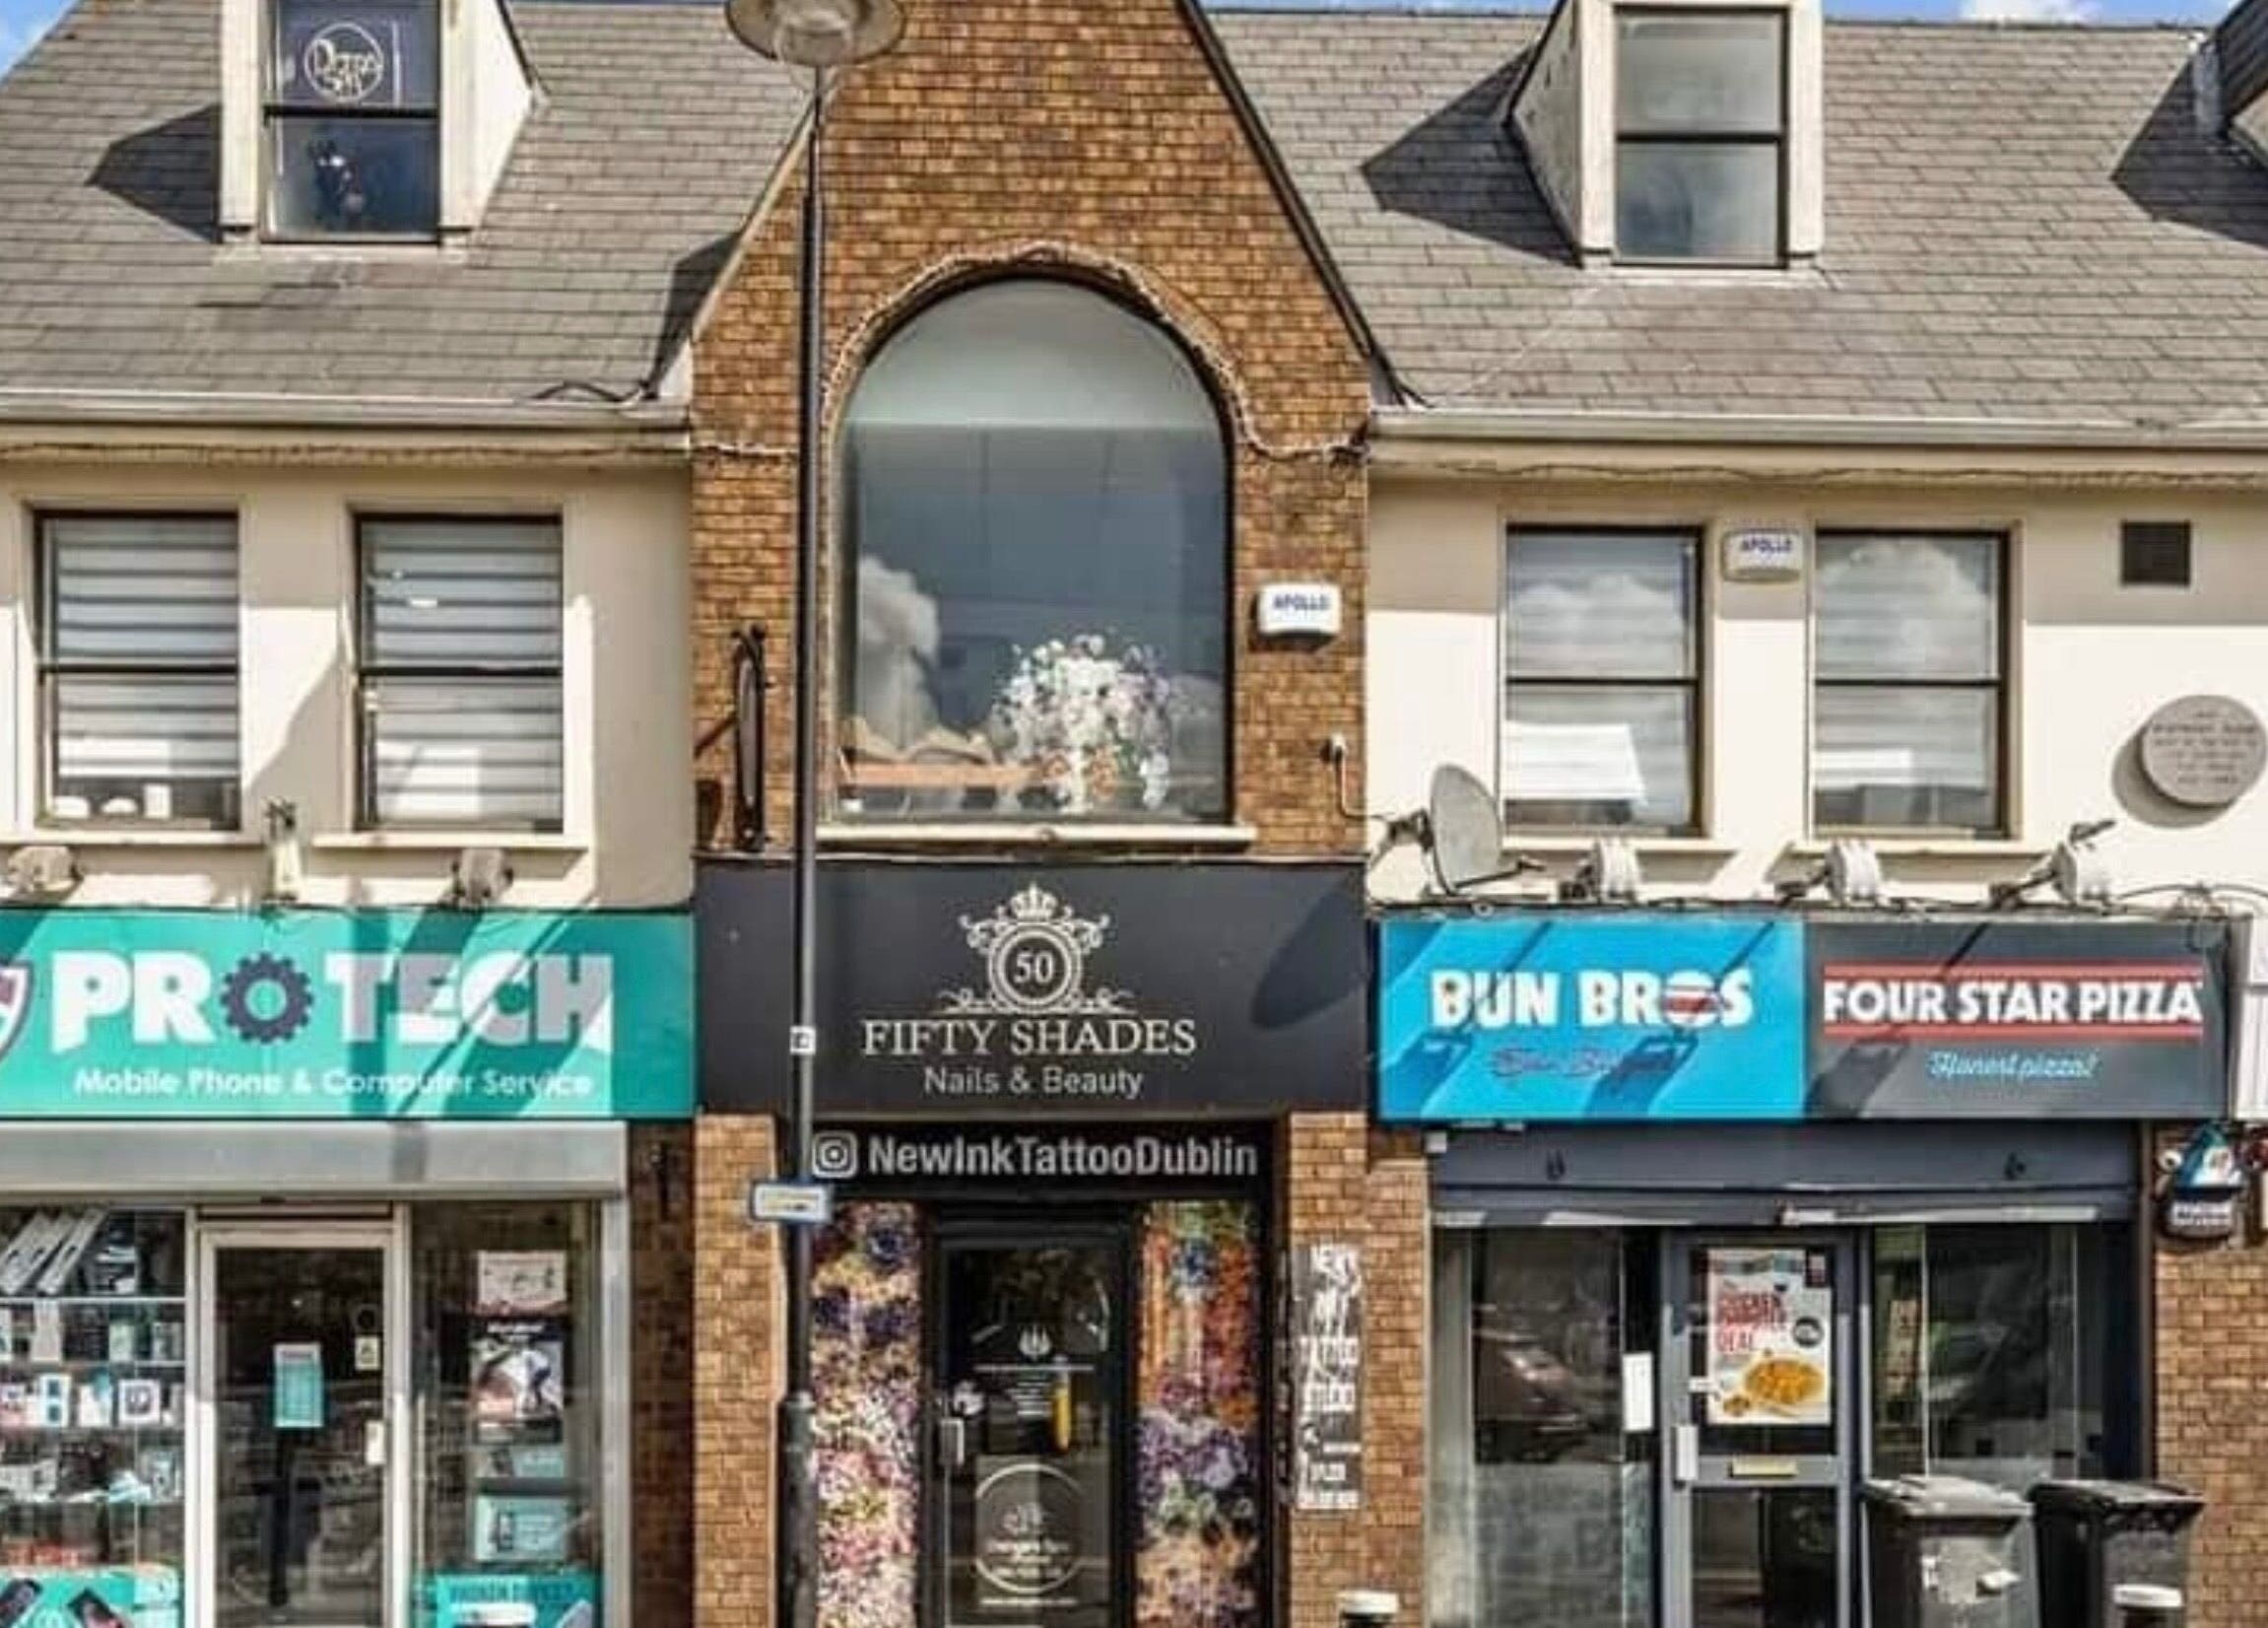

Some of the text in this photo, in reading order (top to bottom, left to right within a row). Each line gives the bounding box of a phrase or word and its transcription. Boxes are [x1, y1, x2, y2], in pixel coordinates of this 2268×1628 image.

[1014, 948, 1055, 984] 50
[1431, 968, 1754, 1028] BUN BROS
[1824, 979, 2202, 1023] FOUR STAR PIZZA
[861, 1018, 1198, 1056] FIFTY SHADES
[75, 1067, 593, 1101] Mobile Phone & Computer Service
[923, 1065, 1144, 1099] Nails & Beauty
[868, 1134, 1259, 1177] NewInkTattooDublin
